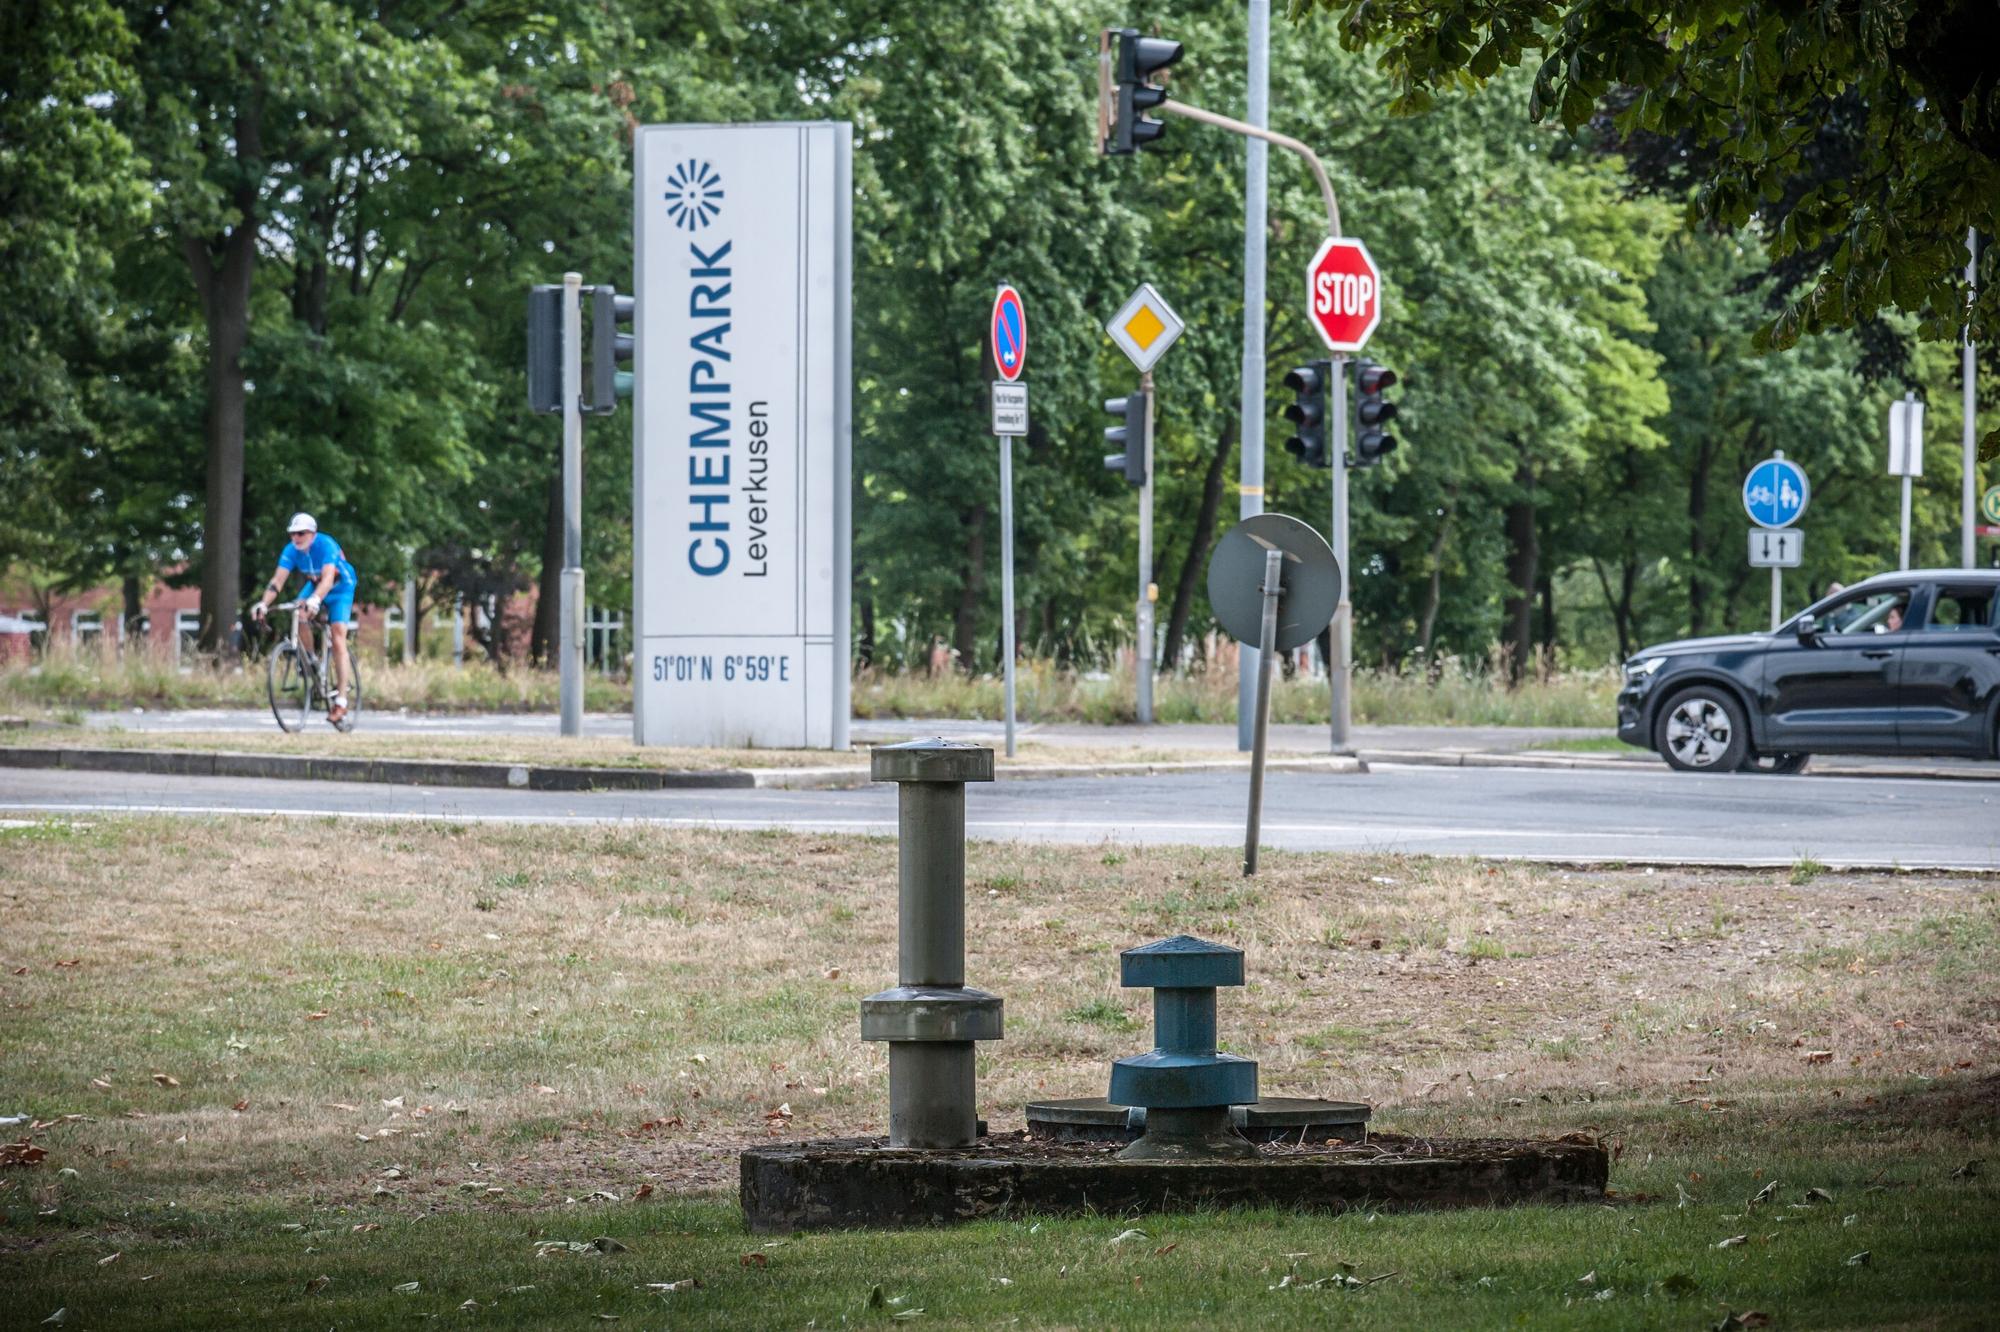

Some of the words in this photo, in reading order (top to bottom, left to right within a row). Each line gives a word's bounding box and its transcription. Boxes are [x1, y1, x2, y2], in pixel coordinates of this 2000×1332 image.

[1316, 271, 1373, 316] STOP
[688, 239, 732, 577] CHEMPARK
[742, 401, 768, 577] Leverkusen
